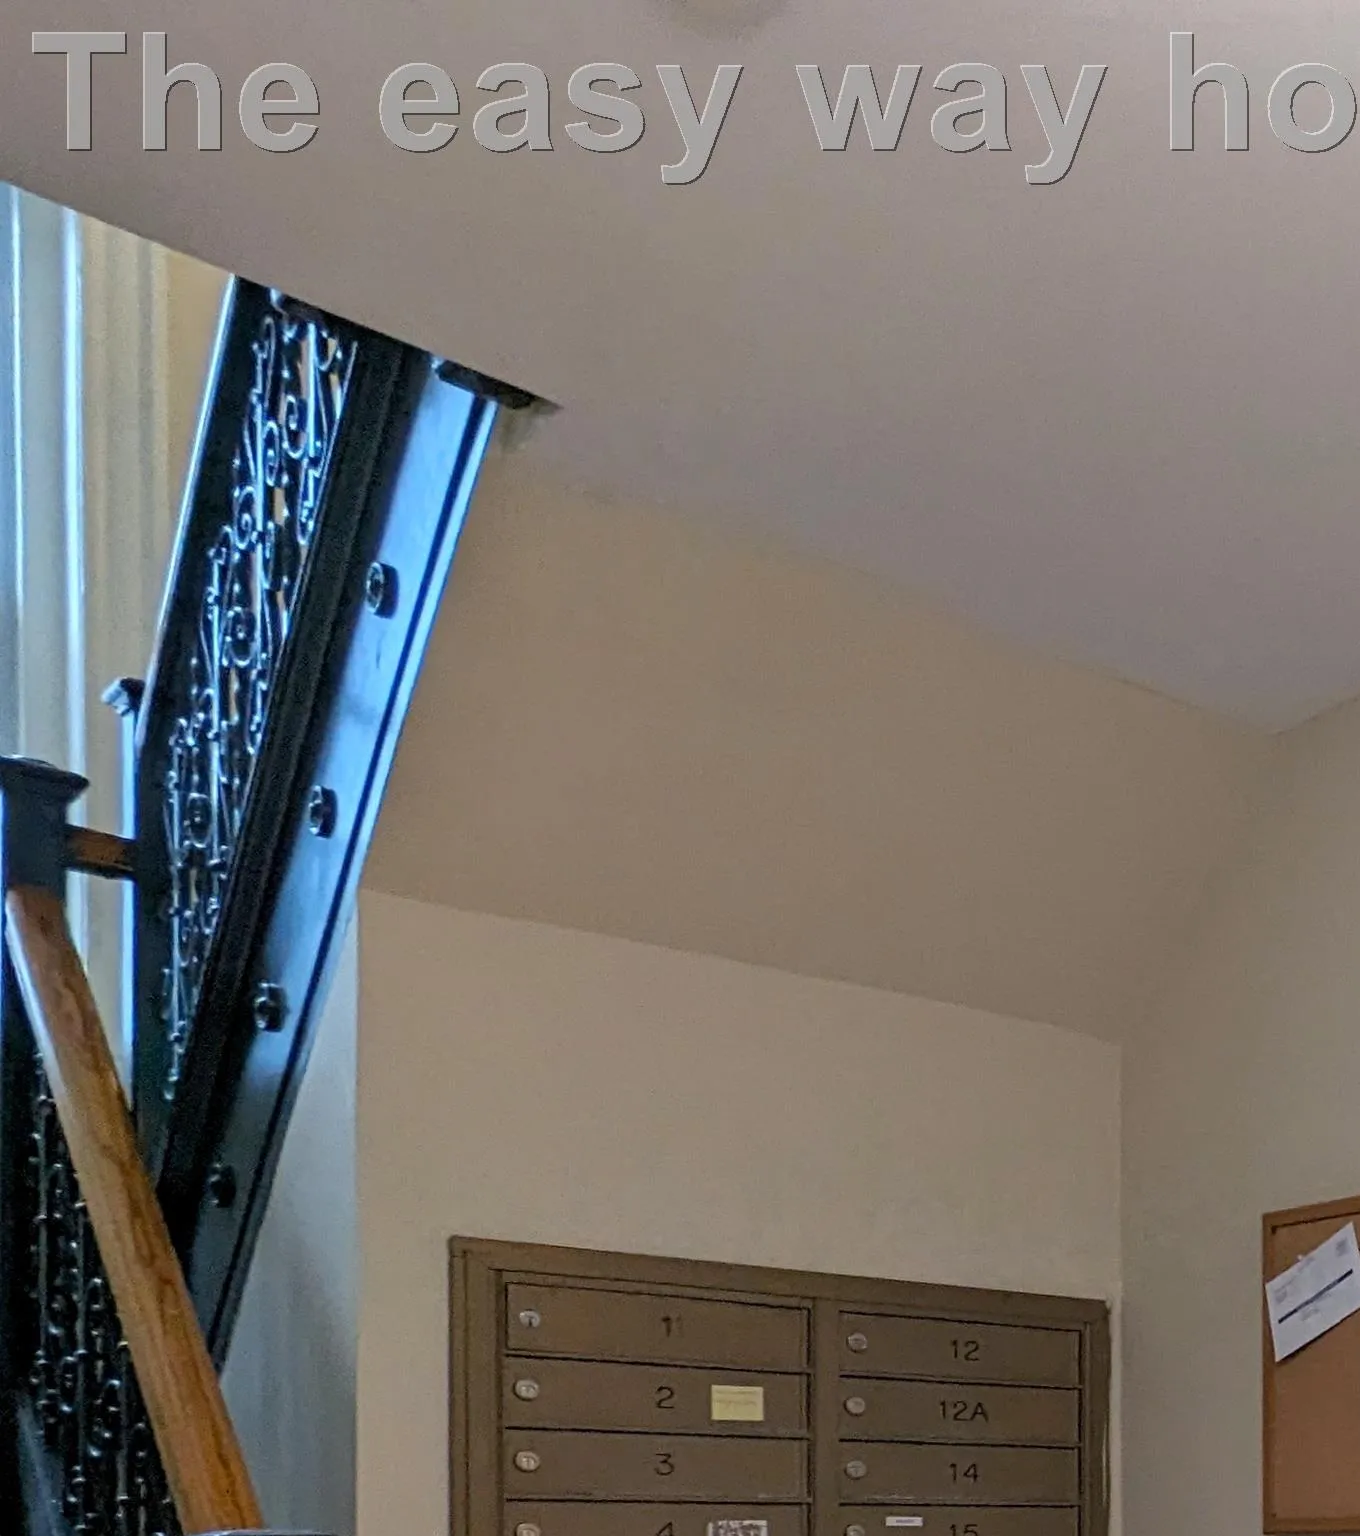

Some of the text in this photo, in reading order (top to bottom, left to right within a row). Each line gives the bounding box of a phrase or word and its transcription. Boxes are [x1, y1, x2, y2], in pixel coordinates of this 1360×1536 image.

[951, 1339, 980, 1362] 12
[655, 1386, 675, 1410] 2
[939, 1400, 989, 1423] 12A
[655, 1452, 675, 1476] 3
[949, 1462, 979, 1483] 14
